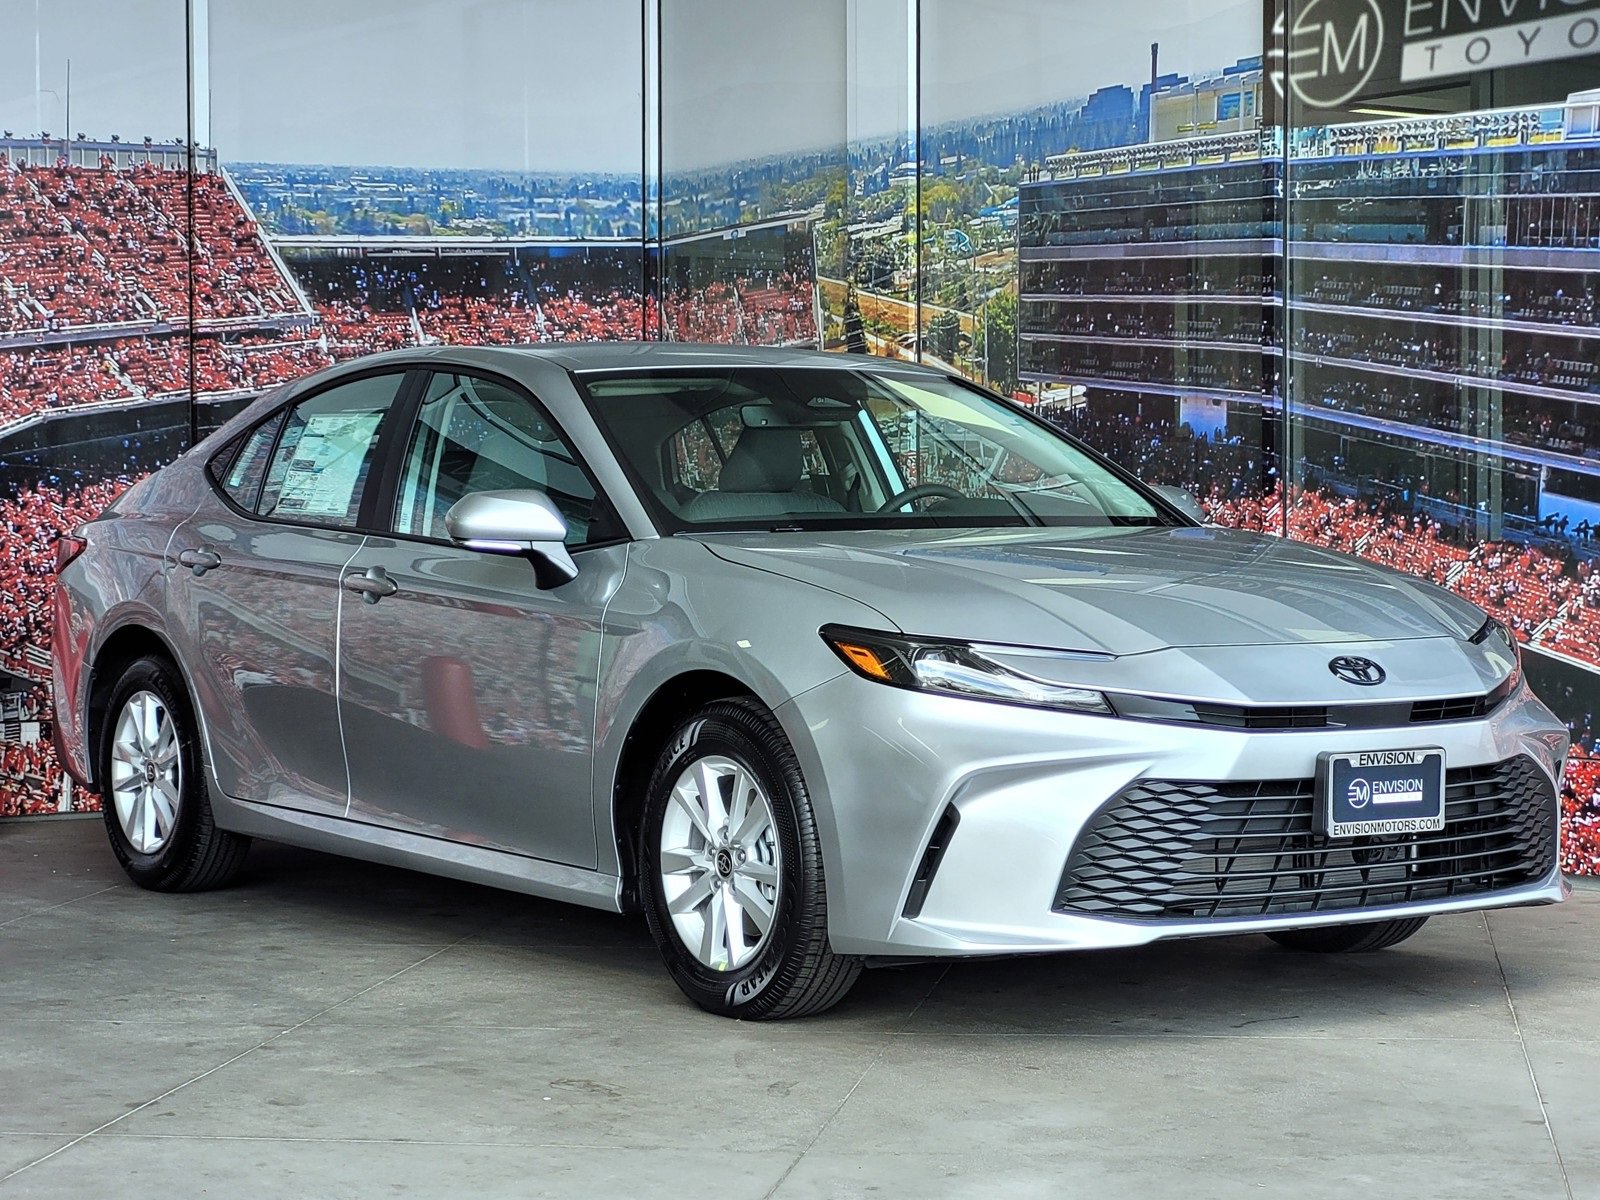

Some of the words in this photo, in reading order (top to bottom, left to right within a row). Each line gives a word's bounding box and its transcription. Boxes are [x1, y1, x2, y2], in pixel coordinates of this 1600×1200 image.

[1359, 751, 1415, 766] ENVISION
[1372, 778, 1424, 794] ENVISION
[1333, 818, 1441, 836] ENVISIONMOTORS.COM
